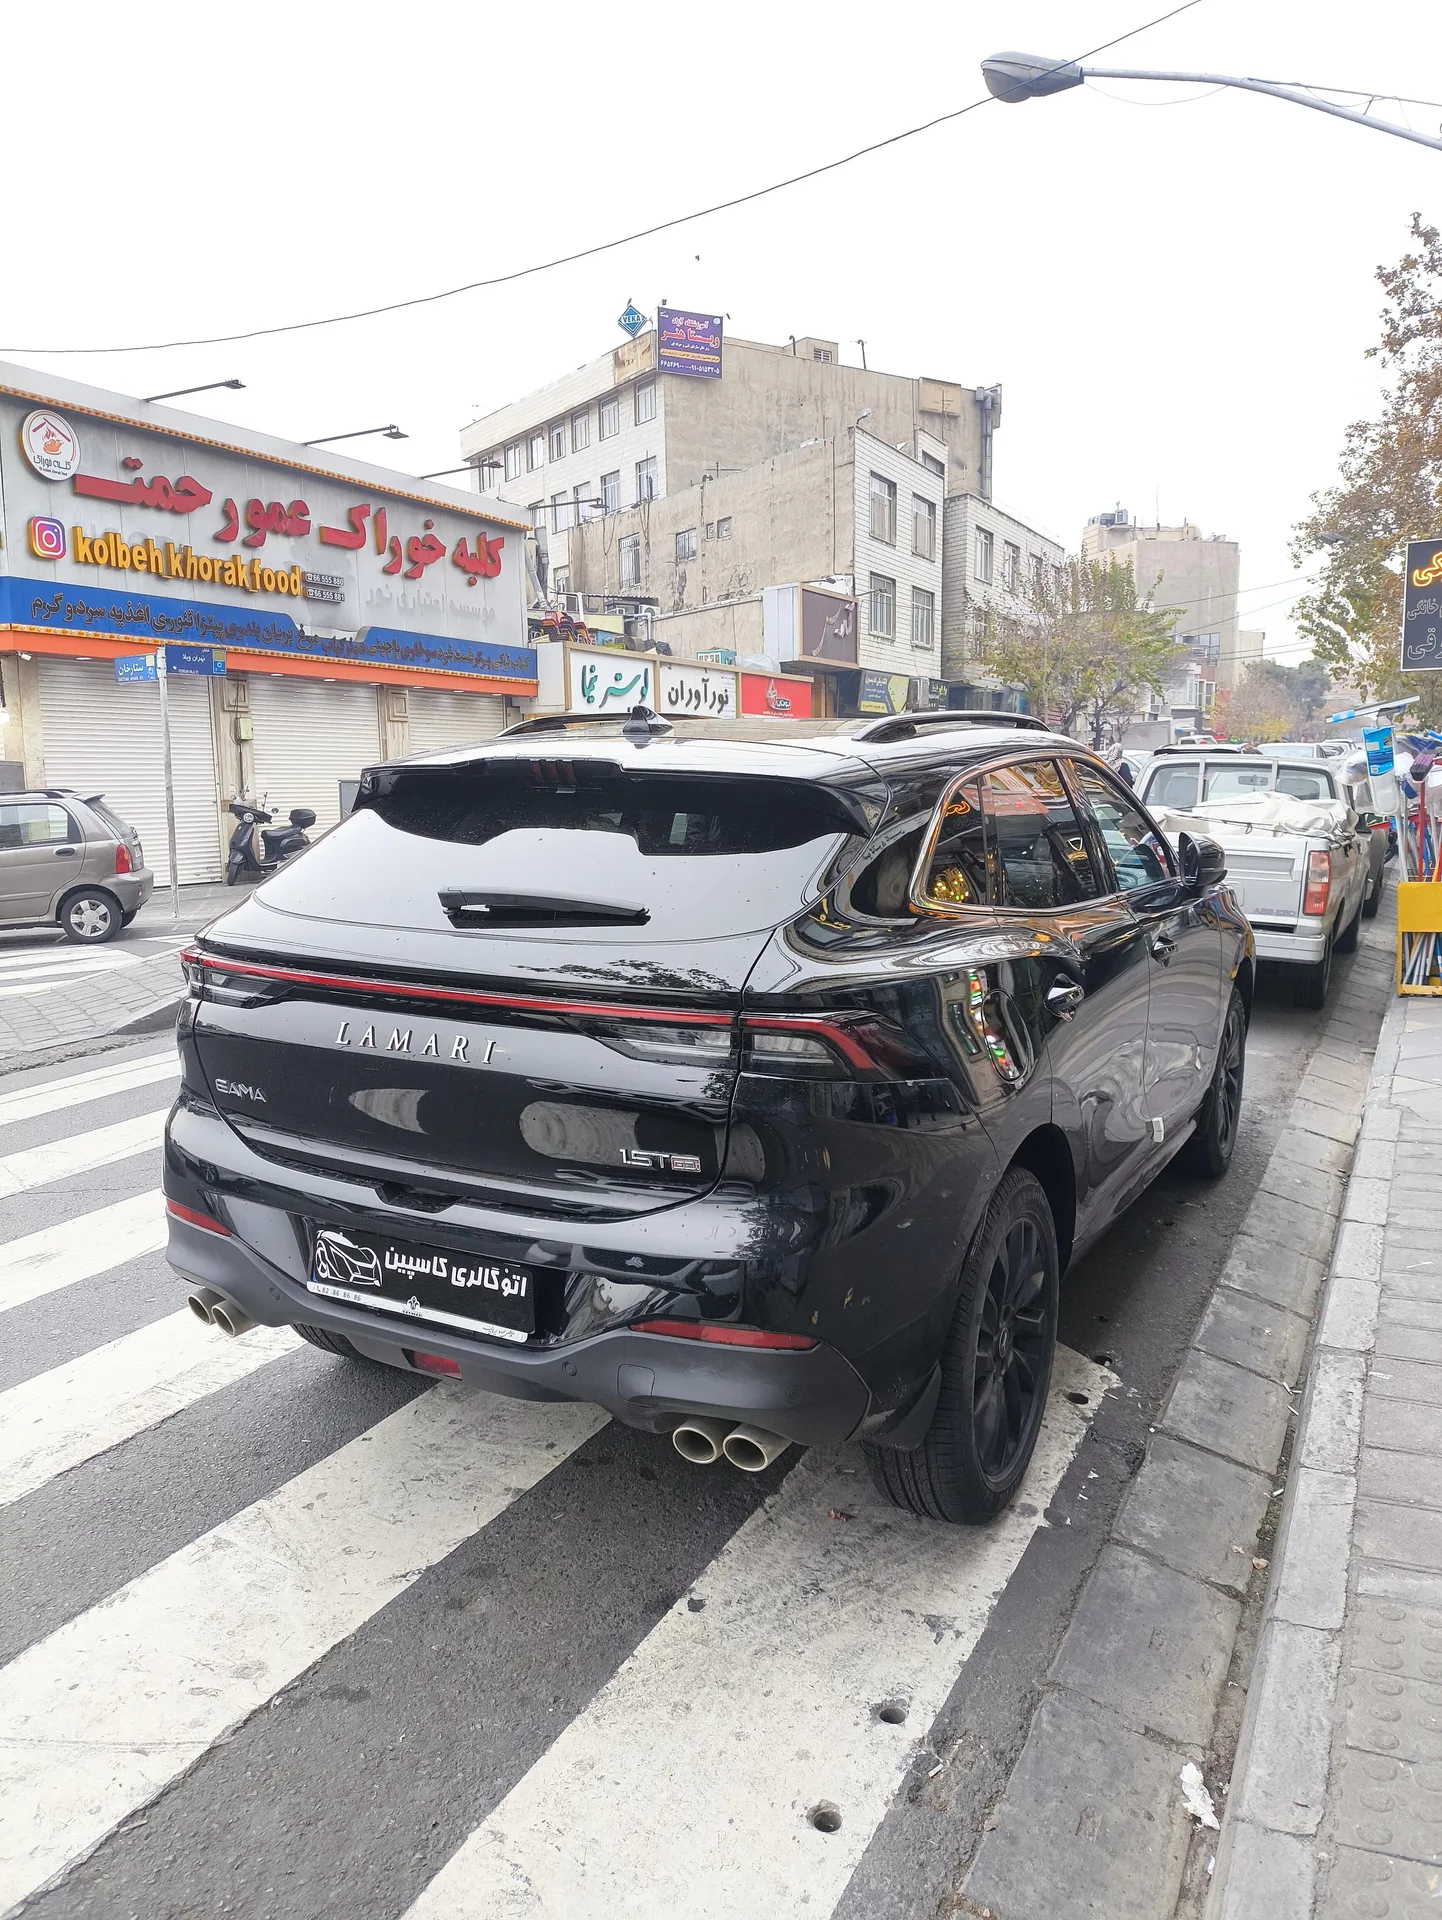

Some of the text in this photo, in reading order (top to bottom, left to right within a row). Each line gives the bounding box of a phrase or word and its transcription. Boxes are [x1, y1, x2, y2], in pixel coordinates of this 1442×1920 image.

[242, 498, 312, 547] عمو
[318, 503, 447, 579] خوراک
[452, 531, 505, 587] کلبه
[322, 575, 332, 584] 555
[32, 592, 64, 620] گرم
[322, 590, 333, 600] 555
[64, 602, 74, 622] و
[75, 599, 106, 624] سرد
[108, 600, 151, 628] اغذیه
[152, 609, 194, 634] تنوری
[1406, 598, 1439, 620] خانگی
[262, 621, 294, 647] بریان
[296, 623, 319, 651] مرغ
[118, 663, 144, 676] ستارخان
[182, 654, 205, 662] تهران ویلا
[335, 1022, 496, 1064] LAMARI
[215, 1078, 266, 1102] EAMA
[384, 1246, 448, 1280] کاسپین
